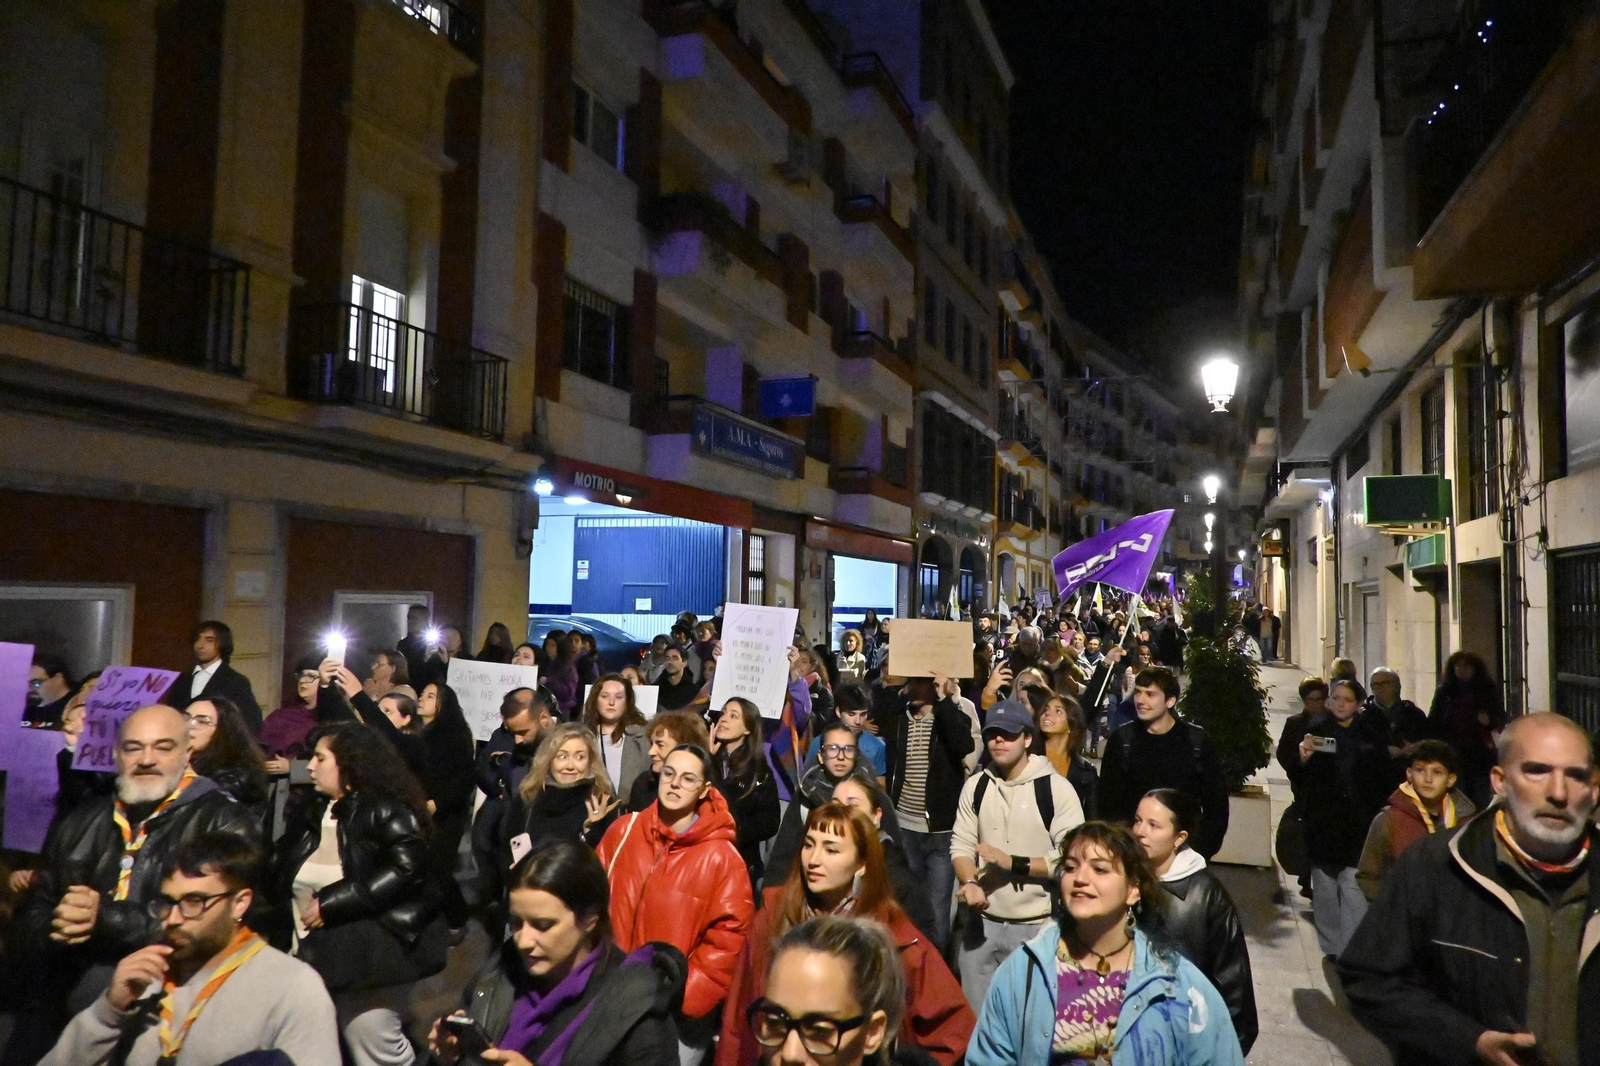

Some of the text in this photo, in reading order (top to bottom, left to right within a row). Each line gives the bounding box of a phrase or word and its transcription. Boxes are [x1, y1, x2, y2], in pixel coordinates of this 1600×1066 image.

[136, 672, 170, 694] NO
[453, 668, 522, 687] GRITAMOS AHORA
